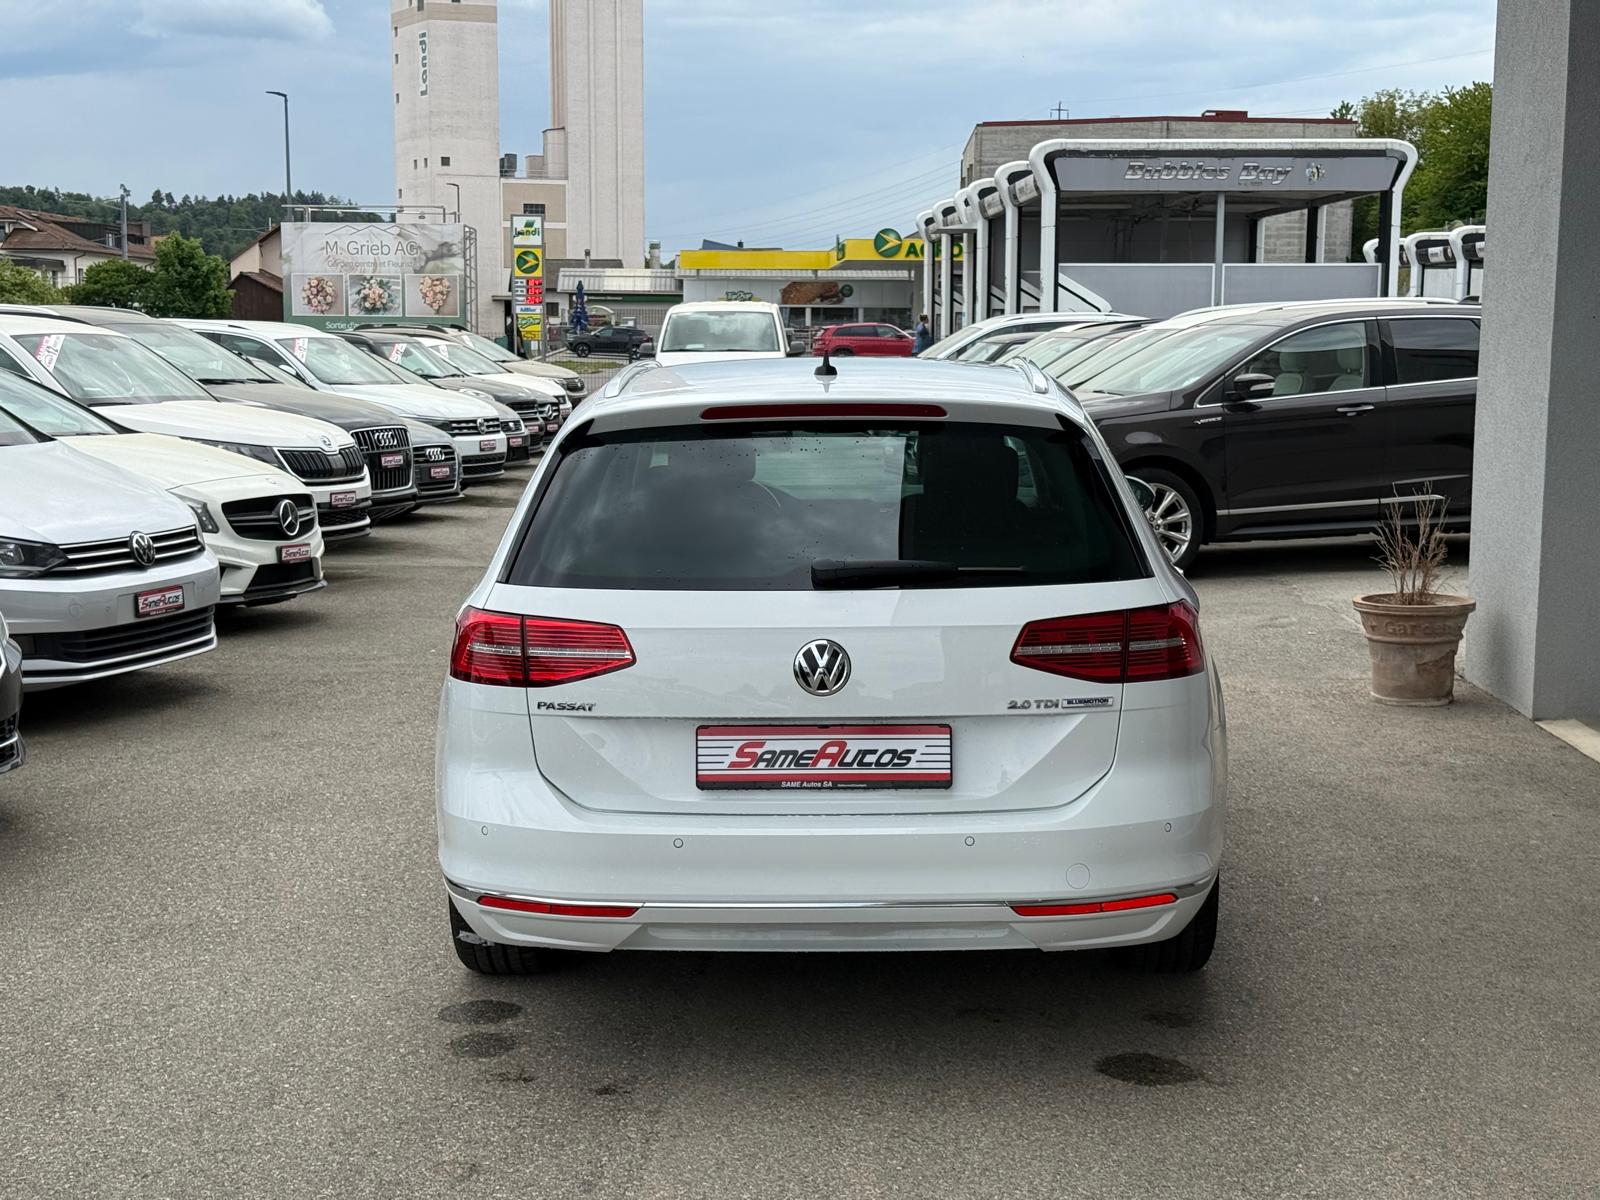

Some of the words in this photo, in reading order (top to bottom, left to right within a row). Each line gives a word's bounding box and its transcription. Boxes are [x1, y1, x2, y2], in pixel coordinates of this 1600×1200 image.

[1124, 161, 1231, 180] Bubbles
[1238, 162, 1293, 185] Bay
[325, 240, 343, 256] M.
[346, 240, 391, 256] Grieb
[394, 240, 419, 256] AG
[537, 701, 597, 712] PASSAT
[1007, 699, 1032, 710] 2.0
[1033, 699, 1060, 709] TDI
[780, 780, 801, 788] SAME
[801, 780, 821, 788] Autos
[822, 780, 833, 788] SA
